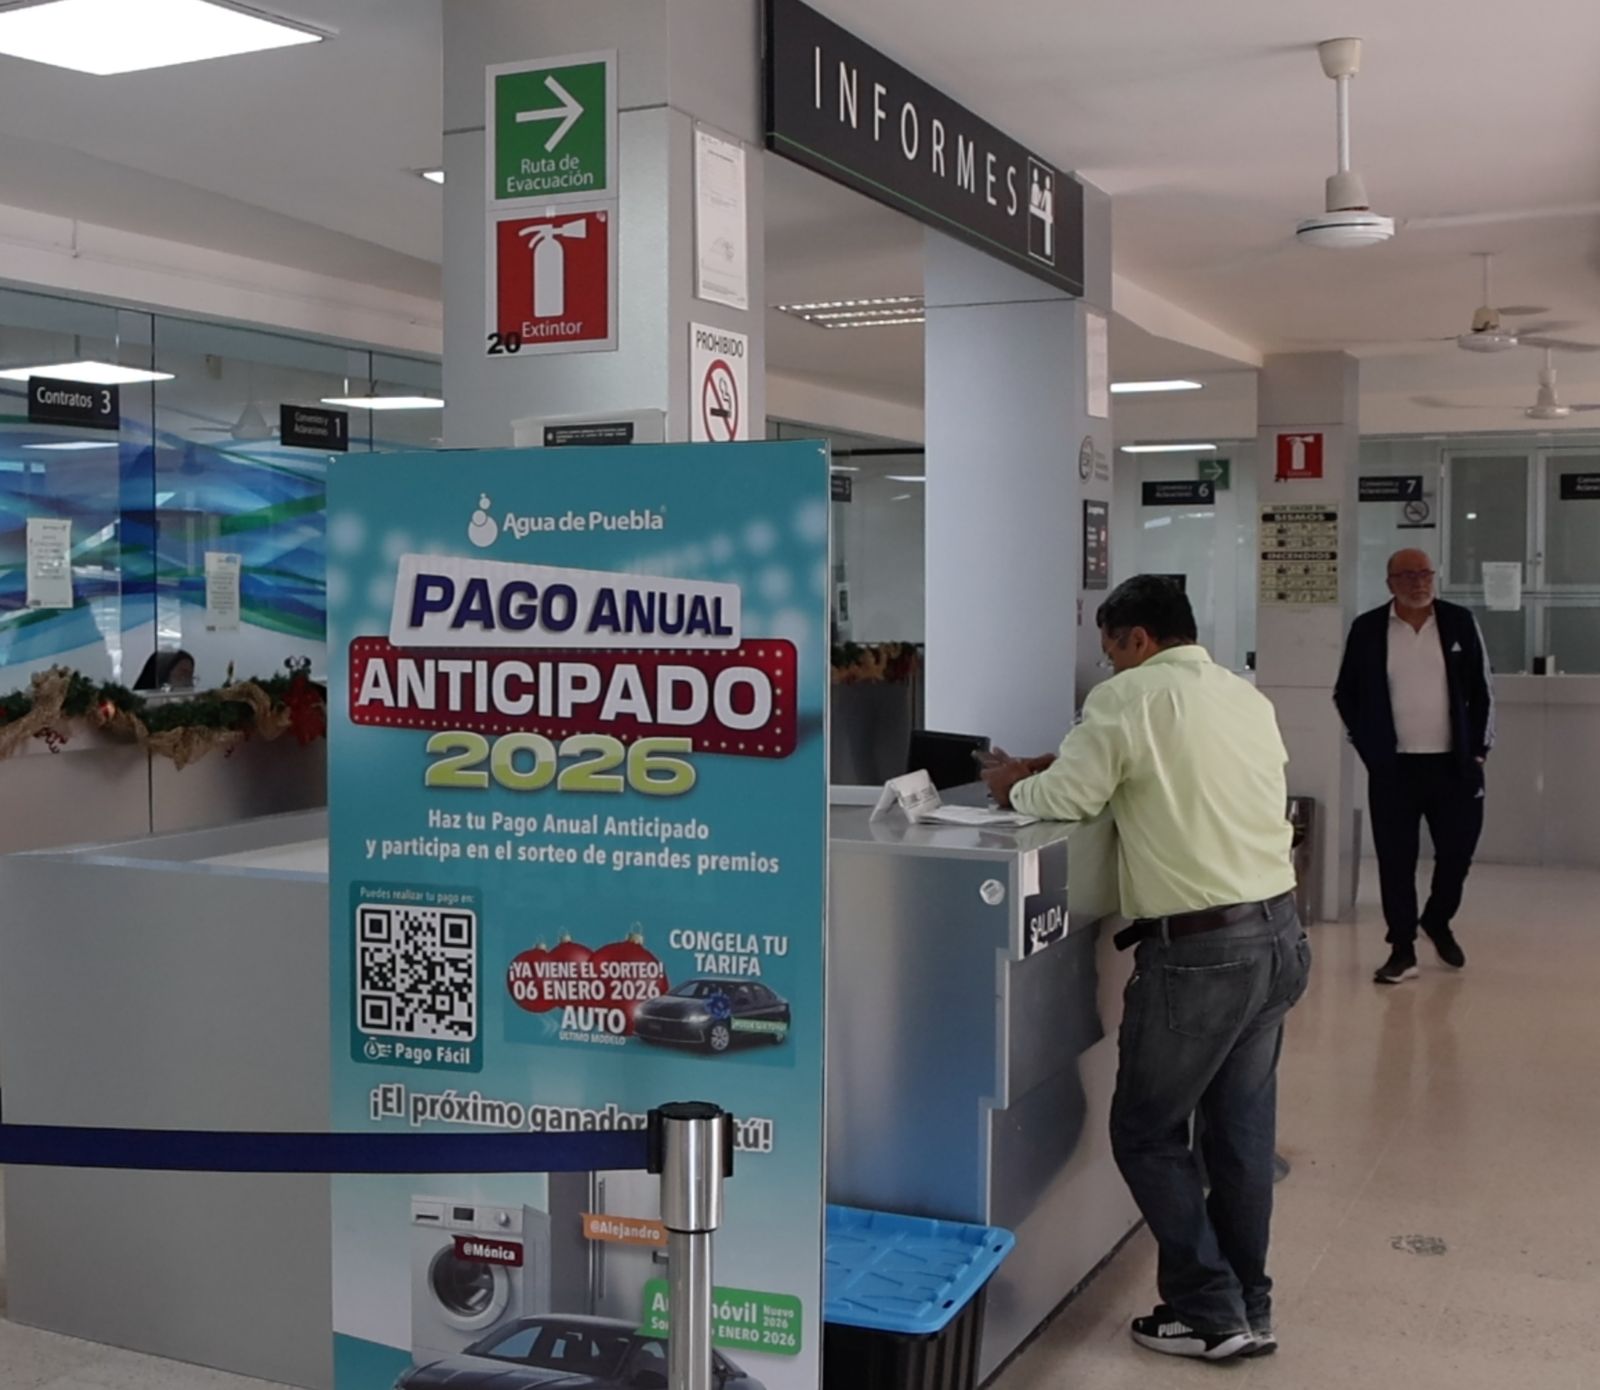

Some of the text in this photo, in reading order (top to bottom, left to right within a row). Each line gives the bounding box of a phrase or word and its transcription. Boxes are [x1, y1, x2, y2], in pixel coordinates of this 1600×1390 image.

[814, 46, 1018, 216] INFORMES
[520, 153, 580, 174] Ruta de
[506, 169, 594, 193] Evacuación
[521, 321, 584, 338] Extintor
[487, 331, 521, 354] 20
[696, 329, 745, 358] PROHIBIDO
[36, 386, 112, 414] Contratos 3
[334, 417, 341, 438] 1
[1198, 483, 1209, 498] 6
[1406, 480, 1417, 494] 7
[503, 509, 664, 540] Agua de Puebla
[1273, 513, 1326, 521] SISMOS
[1266, 552, 1331, 560] INCENDIOS
[408, 572, 733, 637] PAGO ANUAL
[357, 657, 773, 731] ANTICIPADO
[424, 730, 696, 796] 2026
[428, 809, 710, 843] Haz tu Pago Anual Anticipado
[366, 836, 780, 876] y participa en el sorteo de grandes premios
[360, 886, 391, 899] Puedes
[392, 888, 423, 901] realizar
[425, 891, 436, 902] tu
[437, 892, 460, 906] pago
[1030, 904, 1063, 941] SALIDA
[668, 928, 788, 957] CONGELA TU
[509, 960, 665, 981] ¡YA VIENE EL SORTEO!
[694, 952, 762, 976] TARIFA
[512, 979, 661, 1001] 06 ENERO 2026
[560, 1004, 627, 1034] AUTO
[591, 1033, 627, 1046] MODELO
[395, 1043, 471, 1065] Pago Fácil
[370, 1084, 773, 1153] ¡El próximo ganador tú!
[590, 1219, 661, 1241] @Alejandro
[463, 1241, 517, 1262] @Mónica
[763, 1304, 795, 1319] Nuevo
[763, 1316, 789, 1329] 2026
[718, 1324, 760, 1343] ENERO
[763, 1330, 797, 1348] 2026
